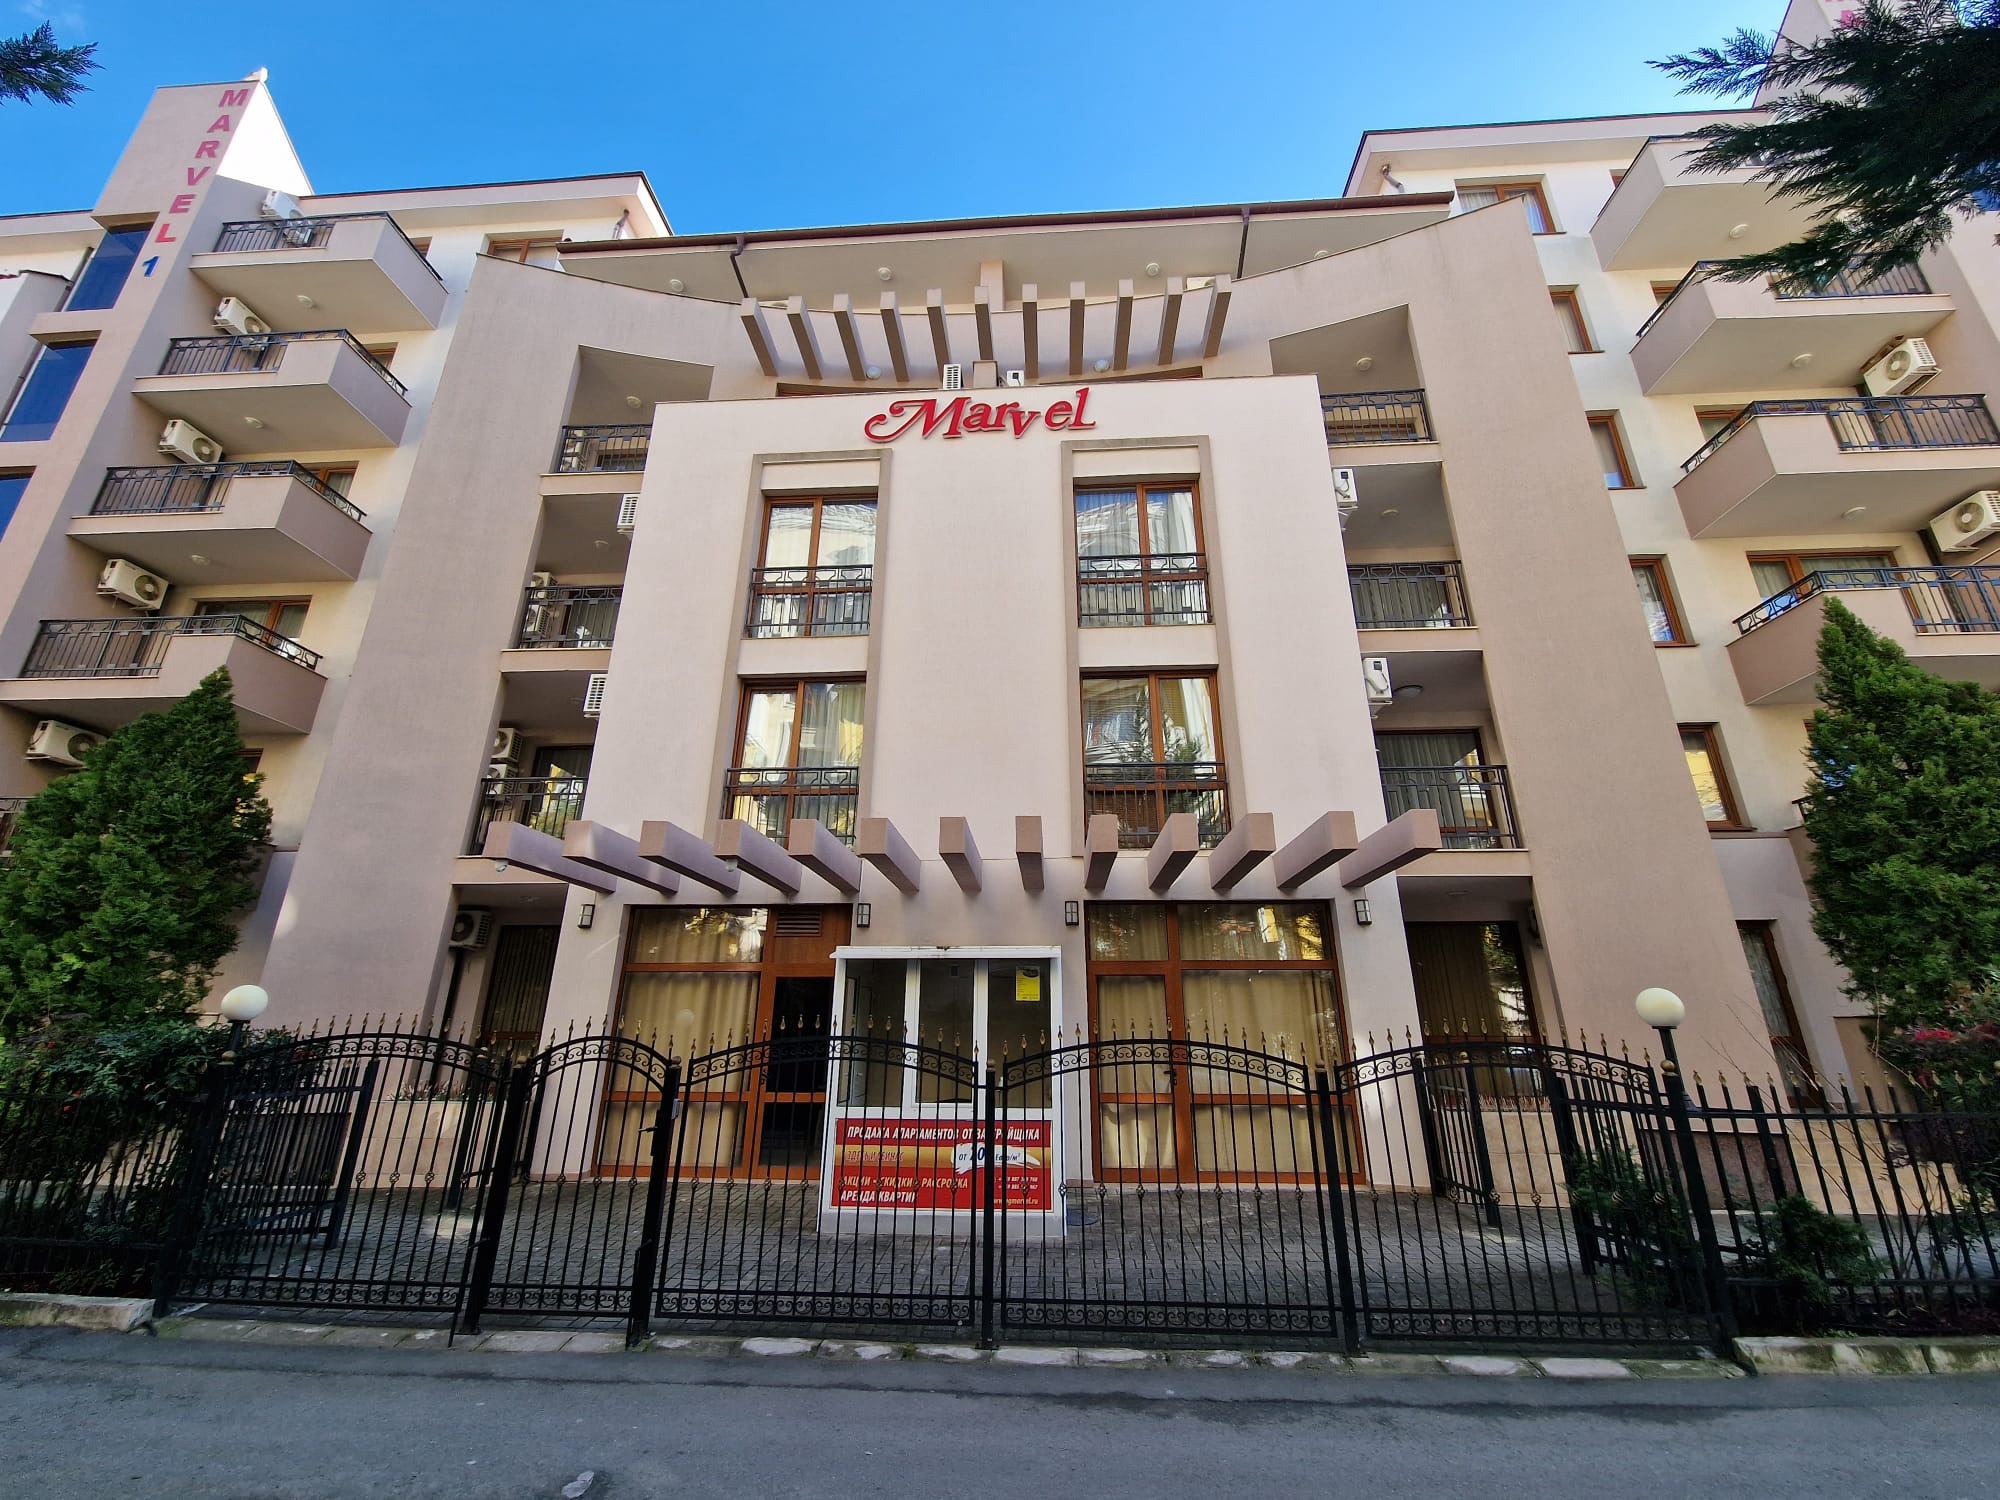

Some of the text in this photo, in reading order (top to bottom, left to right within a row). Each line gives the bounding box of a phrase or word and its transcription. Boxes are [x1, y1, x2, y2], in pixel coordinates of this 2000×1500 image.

[142, 88, 249, 278] MARVEL 1
[864, 387, 1097, 444] Marvel
[921, 1177, 968, 1188] РАССРОКА
